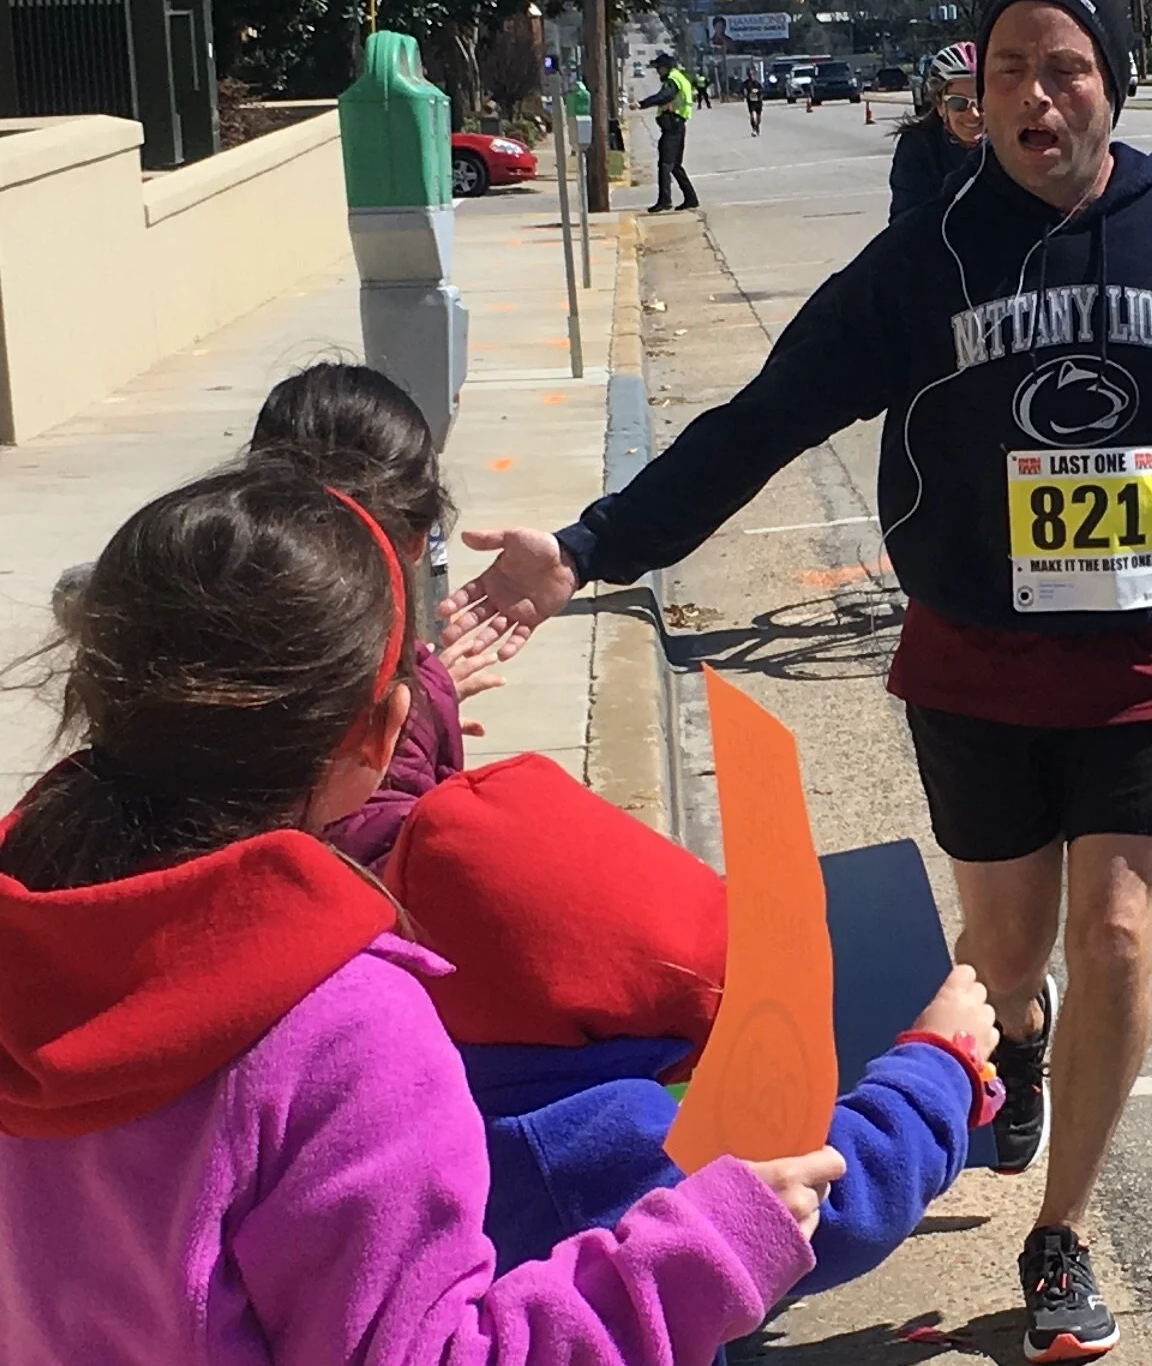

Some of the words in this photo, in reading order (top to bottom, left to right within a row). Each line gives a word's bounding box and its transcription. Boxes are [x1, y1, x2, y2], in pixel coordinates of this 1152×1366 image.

[951, 283, 1099, 370] NITTANY
[1050, 455, 1090, 475] LAST
[1094, 453, 1127, 473] ONE
[1030, 482, 1147, 551] 821
[1030, 559, 1063, 573] MAKE
[1065, 559, 1075, 572] IT
[1078, 558, 1099, 572] THE
[1102, 556, 1129, 572] BEST
[1131, 554, 1152, 569] ONE
